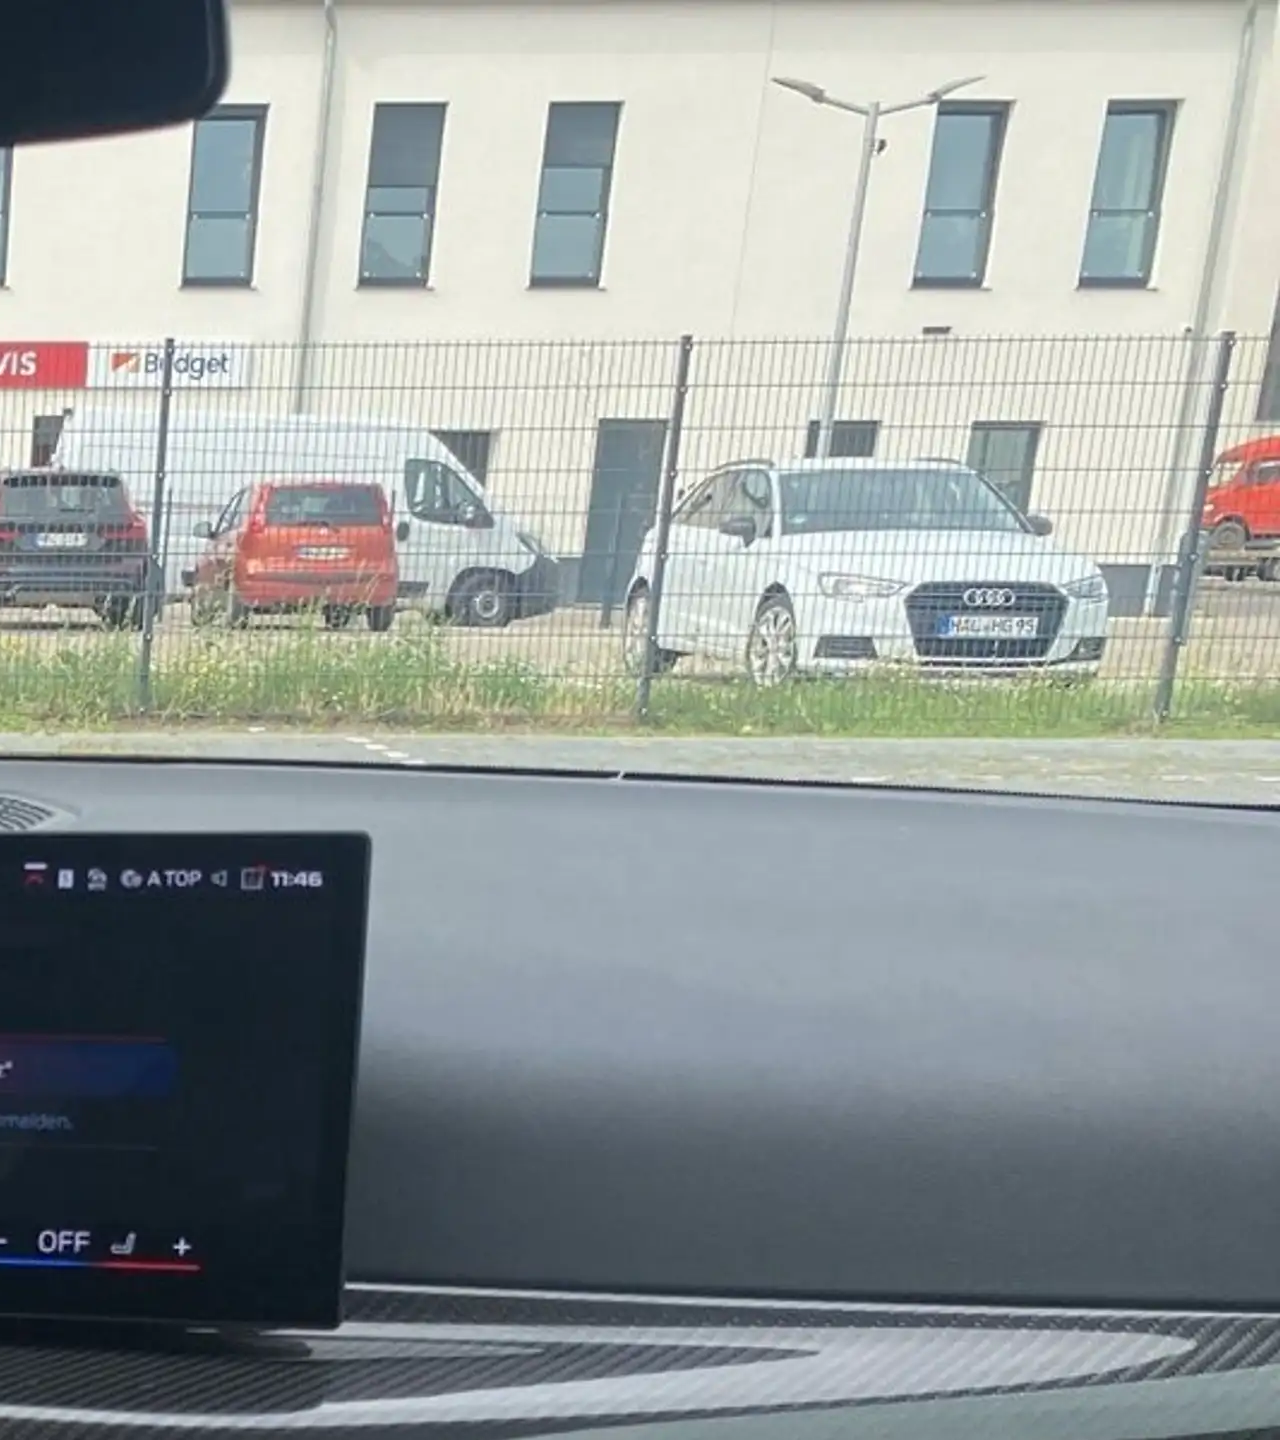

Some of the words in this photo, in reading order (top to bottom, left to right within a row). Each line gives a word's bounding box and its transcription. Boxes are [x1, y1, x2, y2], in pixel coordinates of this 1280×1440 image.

[143, 351, 229, 381] Bdget
[164, 870, 202, 887] TOP
[270, 871, 324, 888] 11:46
[38, 1229, 91, 1254] OFF
